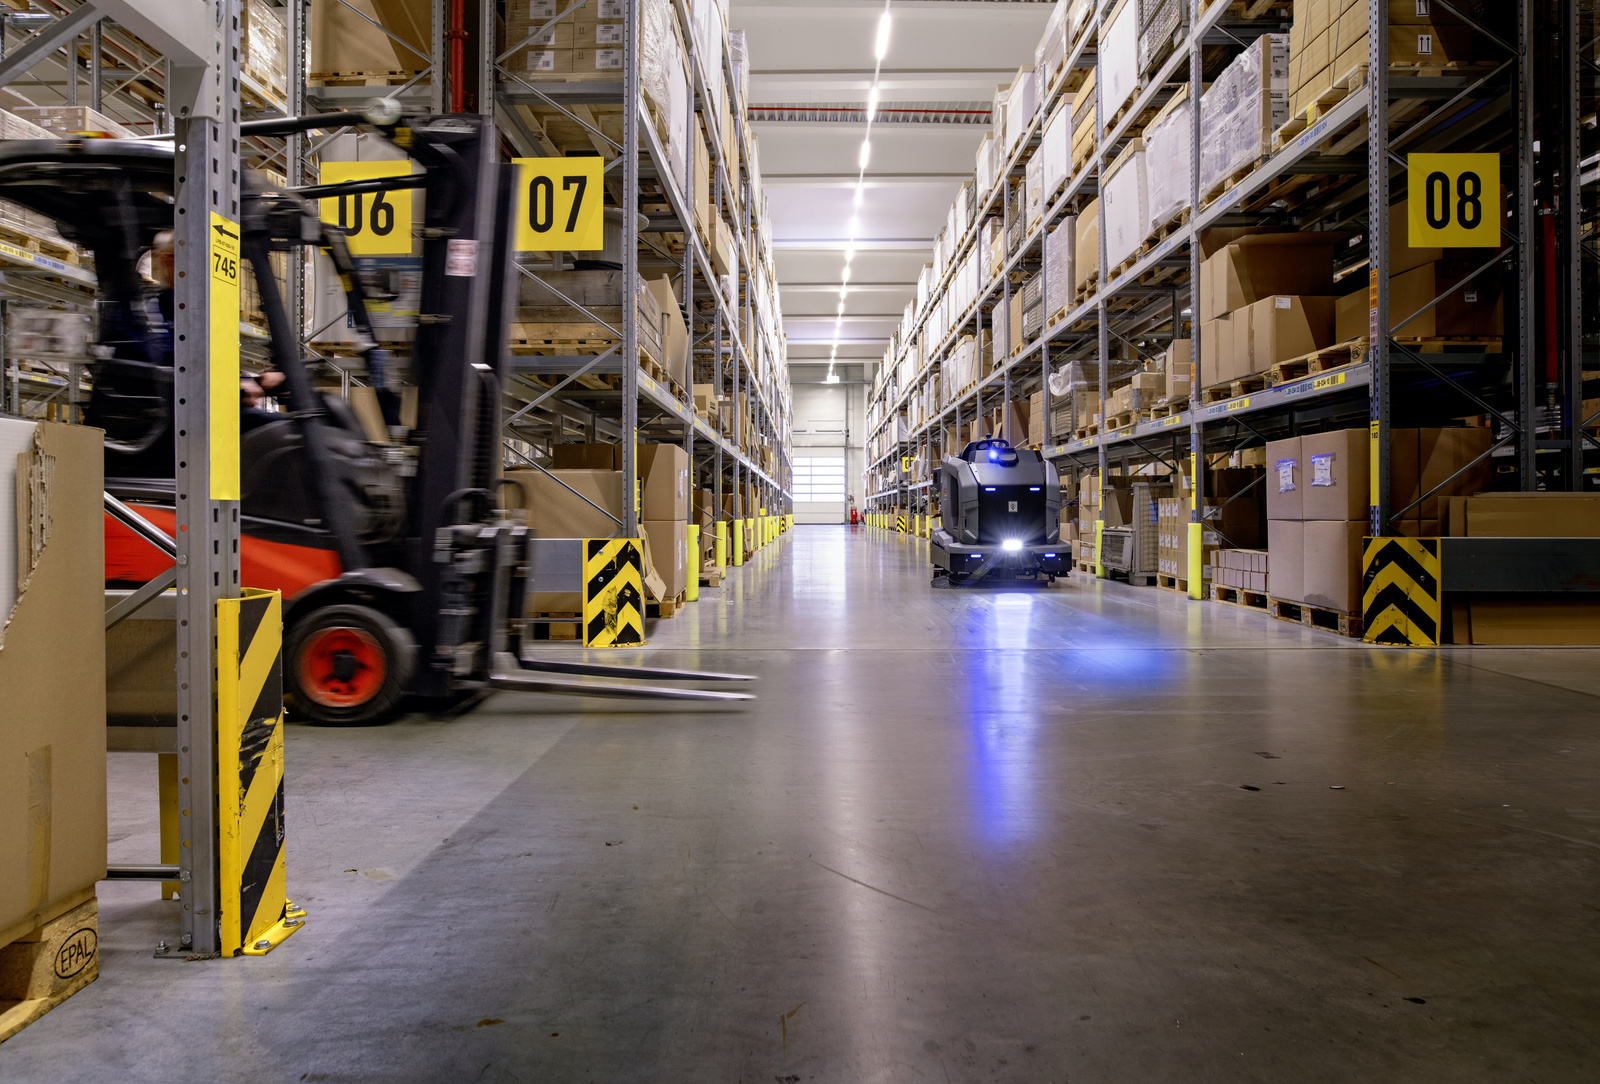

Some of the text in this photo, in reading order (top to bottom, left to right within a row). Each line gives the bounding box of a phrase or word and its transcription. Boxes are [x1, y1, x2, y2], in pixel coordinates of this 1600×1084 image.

[339, 180, 394, 236] 06
[528, 175, 587, 233] 07
[1425, 171, 1482, 229] 08
[213, 252, 236, 280] 745
[60, 936, 92, 973] EPAL
